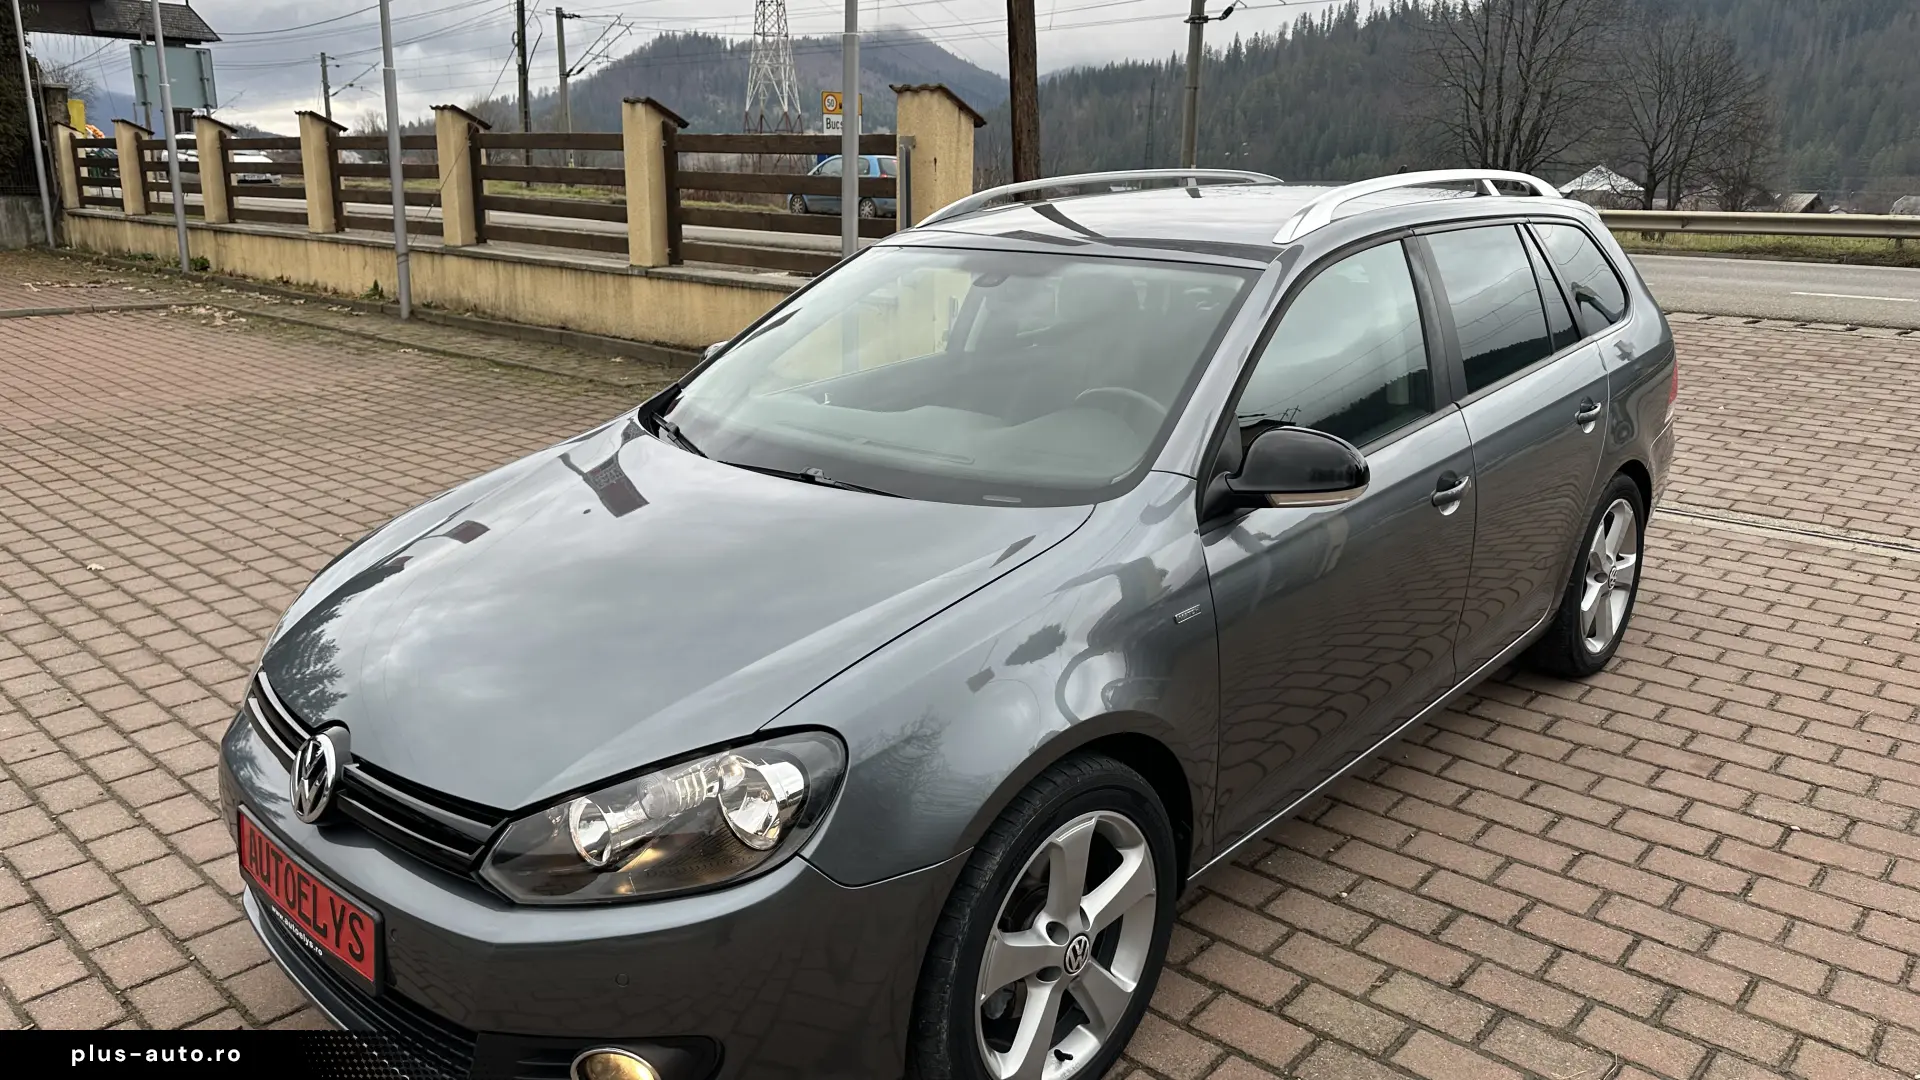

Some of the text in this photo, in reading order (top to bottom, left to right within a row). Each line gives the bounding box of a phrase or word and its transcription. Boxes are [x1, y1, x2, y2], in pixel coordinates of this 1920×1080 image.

[827, 98, 835, 107] 50
[249, 828, 364, 962] AUTOELYS
[271, 904, 323, 956] www.autoelys.ro
